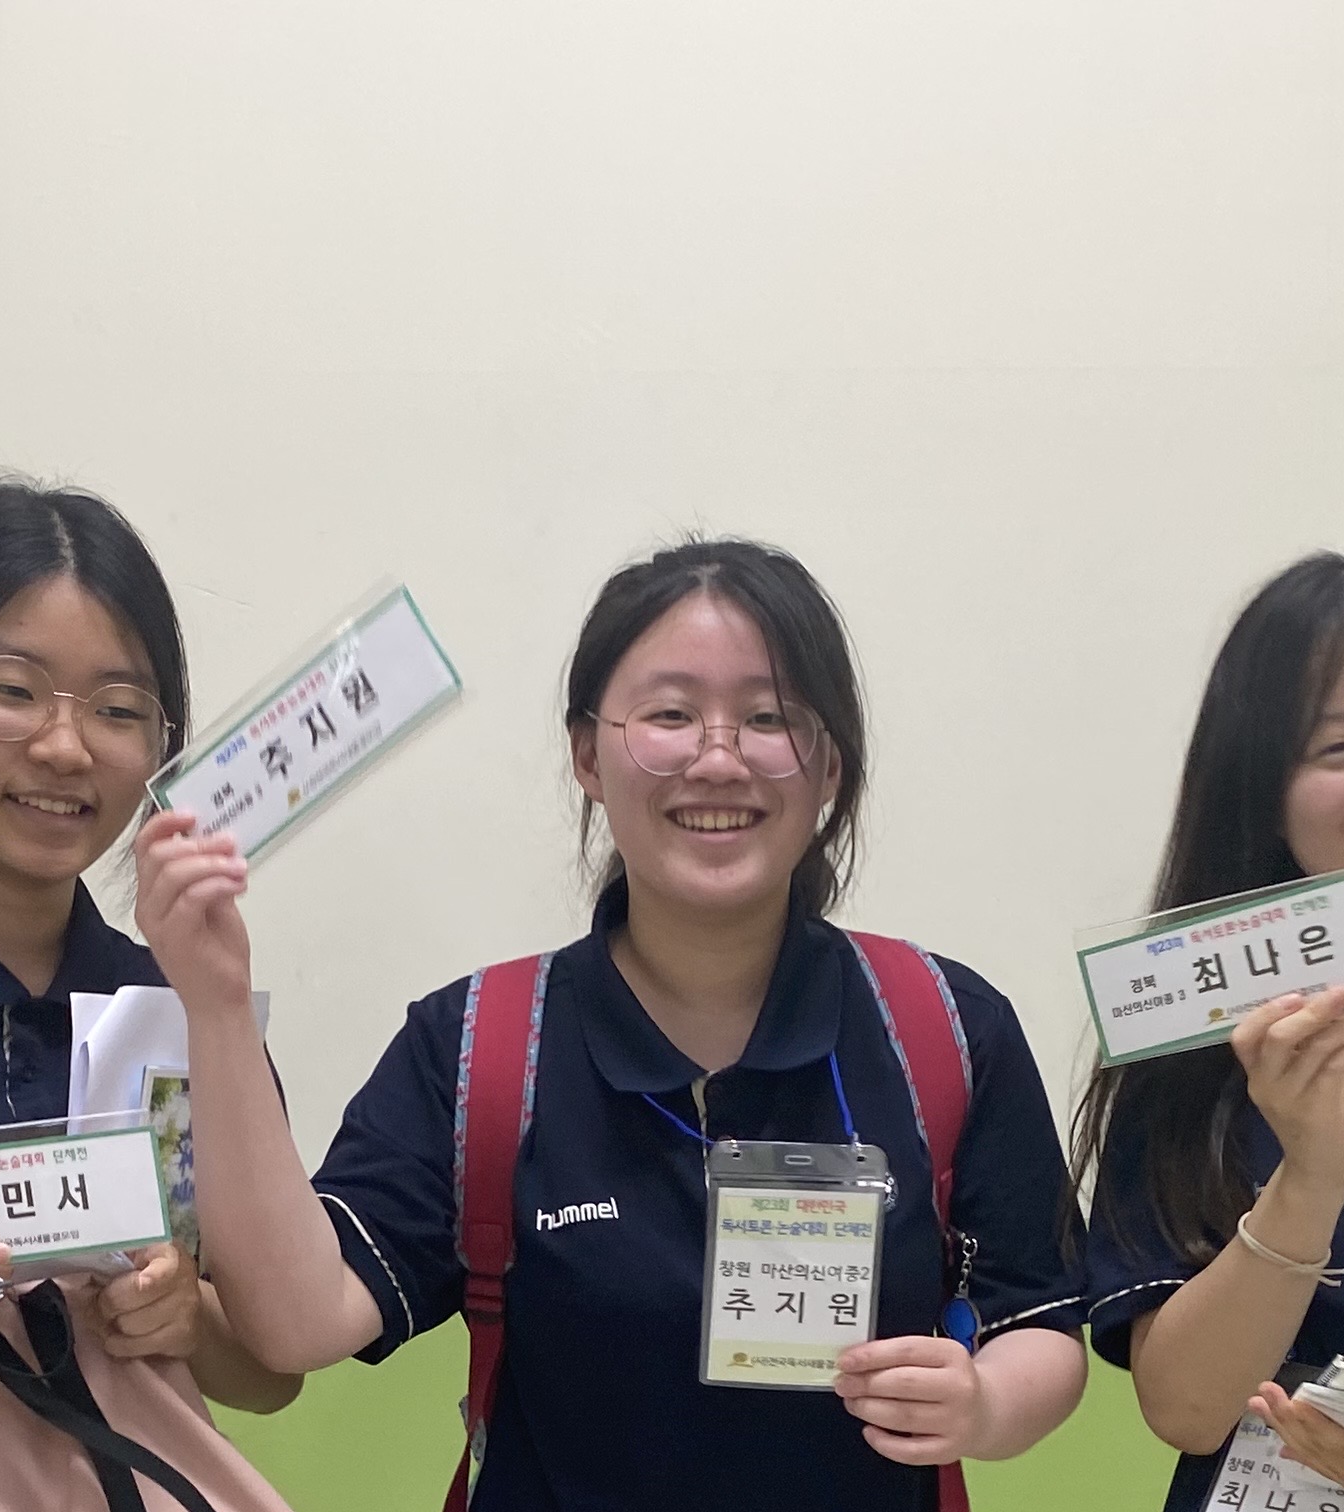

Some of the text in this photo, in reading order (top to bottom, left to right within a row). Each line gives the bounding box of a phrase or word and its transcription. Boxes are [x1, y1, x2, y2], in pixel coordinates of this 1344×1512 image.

[52, 1147, 89, 1164] 단체전
[535, 1197, 619, 1231] hummel
[719, 1260, 752, 1279] 창원
[1227, 1457, 1256, 1475] 창원
